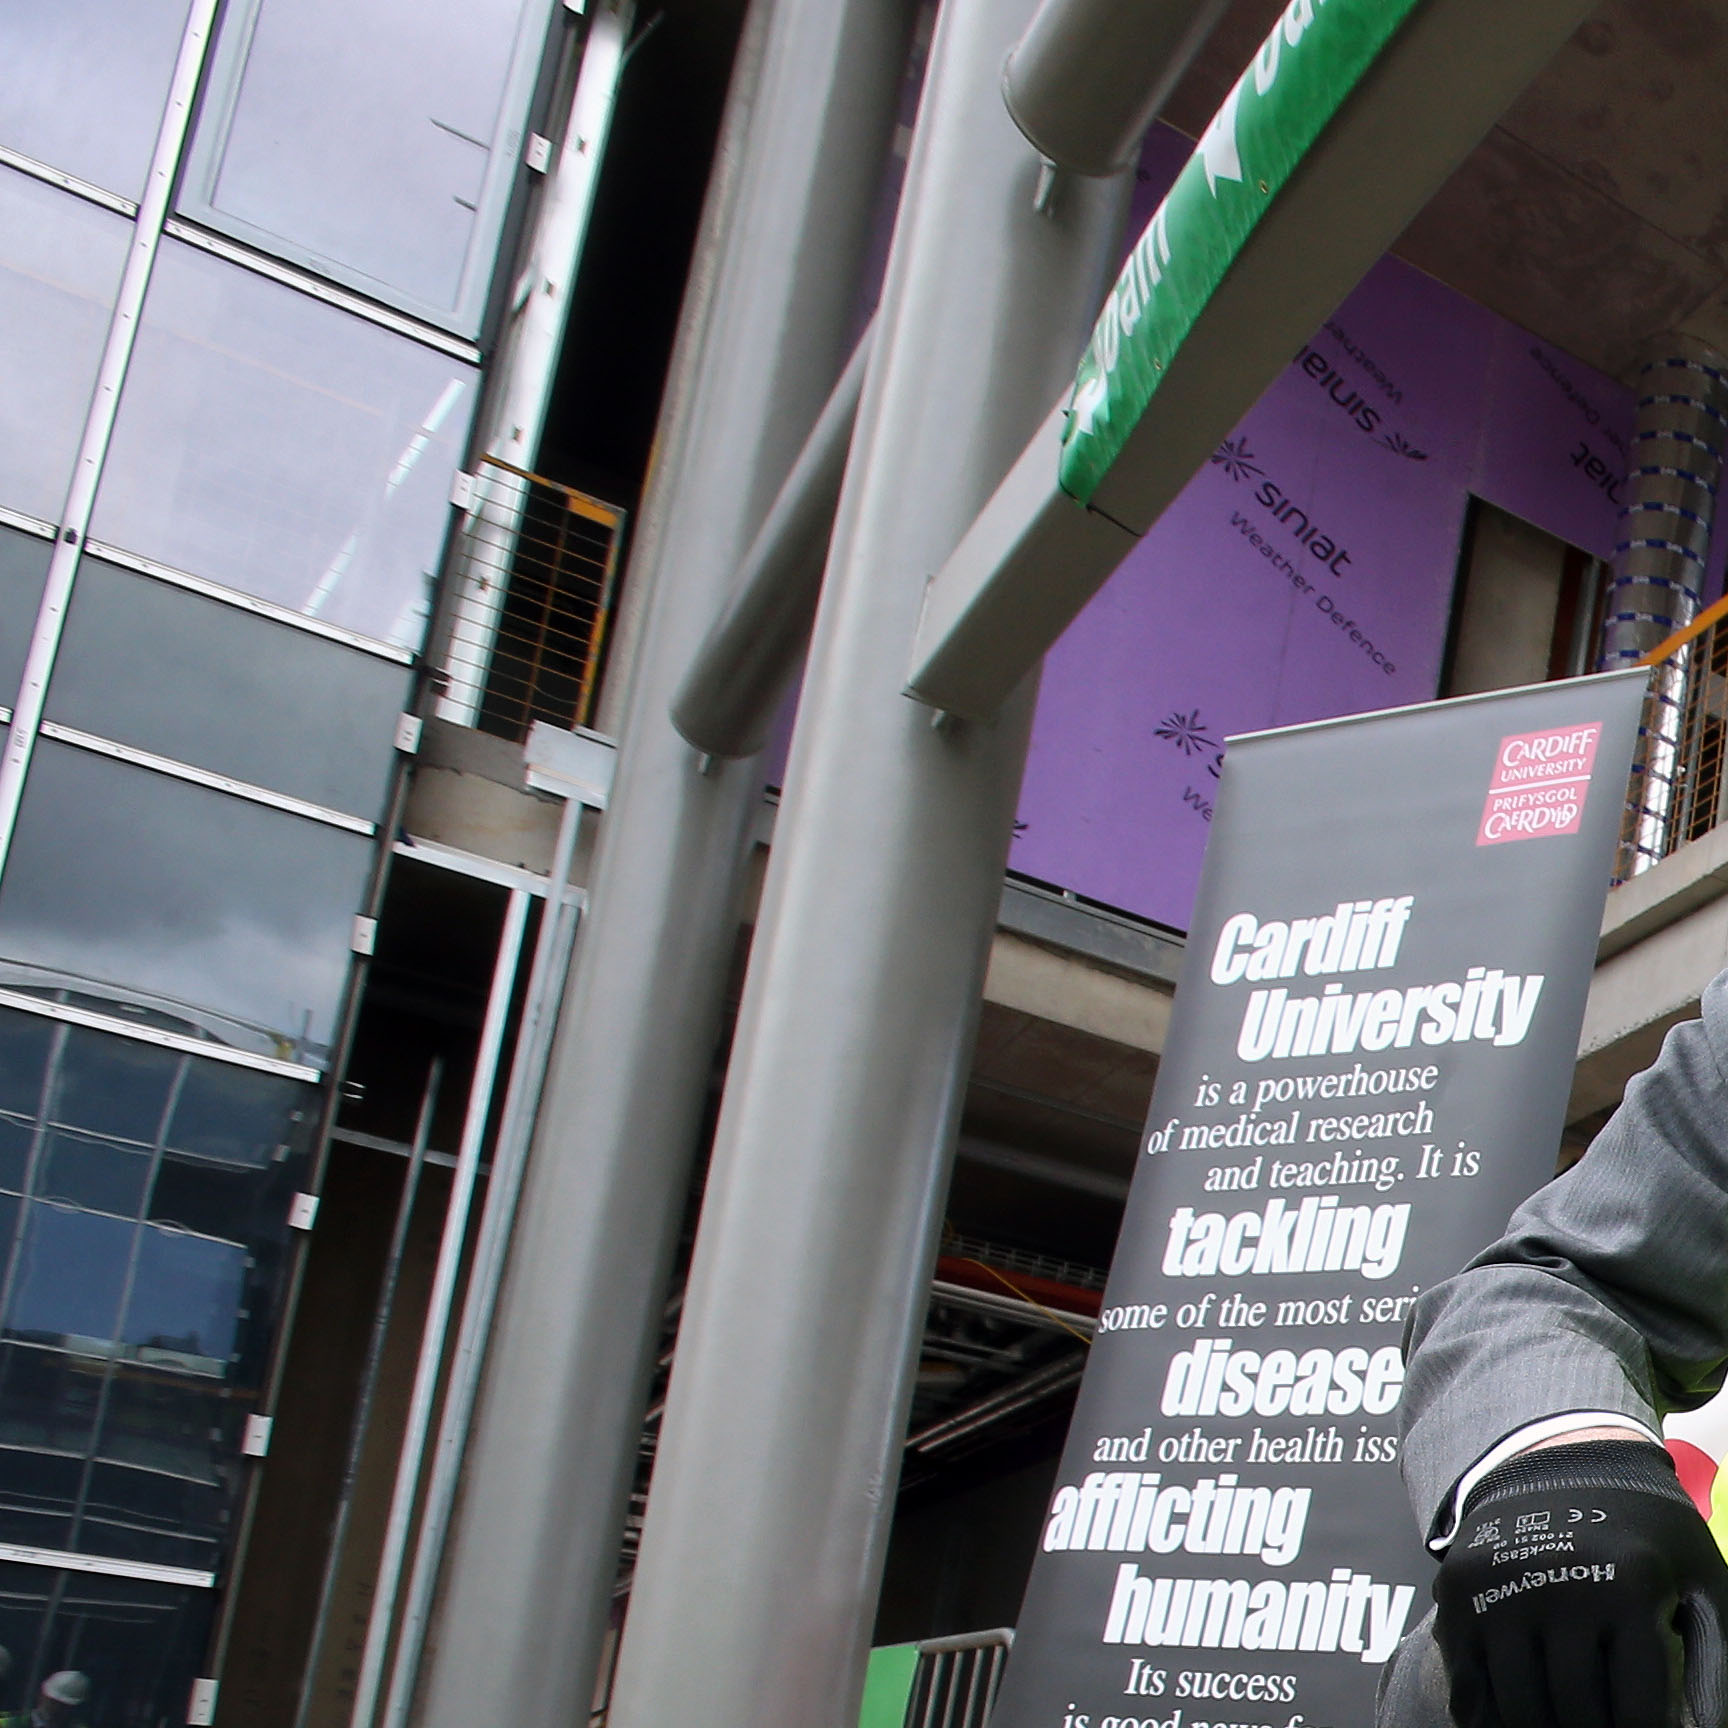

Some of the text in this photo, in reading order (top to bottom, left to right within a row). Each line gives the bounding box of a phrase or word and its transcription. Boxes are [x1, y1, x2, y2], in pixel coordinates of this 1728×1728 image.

[1229, 510, 1396, 676] Weather Defence
[1500, 757, 1587, 782] UNIVERSITY
[1502, 728, 1597, 767] CARDIFF
[1493, 787, 1577, 811] PRIFYSGOL
[1210, 895, 1414, 985] Cardiff
[1236, 966, 1545, 1062] University
[1194, 1063, 1439, 1111] is a powerhouse
[1147, 1101, 1435, 1155] of medical research
[1203, 1141, 1481, 1191] and teaching. It is
[1161, 1195, 1412, 1280] tackling
[1098, 1303, 1168, 1333] some
[1176, 1293, 1217, 1328] of
[1219, 1293, 1266, 1327] the
[1274, 1294, 1353, 1326] most
[1094, 1428, 1152, 1462] and
[1158, 1428, 1242, 1463] other
[1246, 1426, 1344, 1463] health
[1042, 1472, 1312, 1566] afflicting
[1492, 1541, 1575, 1566] WorkEasy
[1103, 1563, 1416, 1663] humanity
[1472, 1563, 1616, 1614] Honeywell
[1124, 1659, 1297, 1702] Its success
